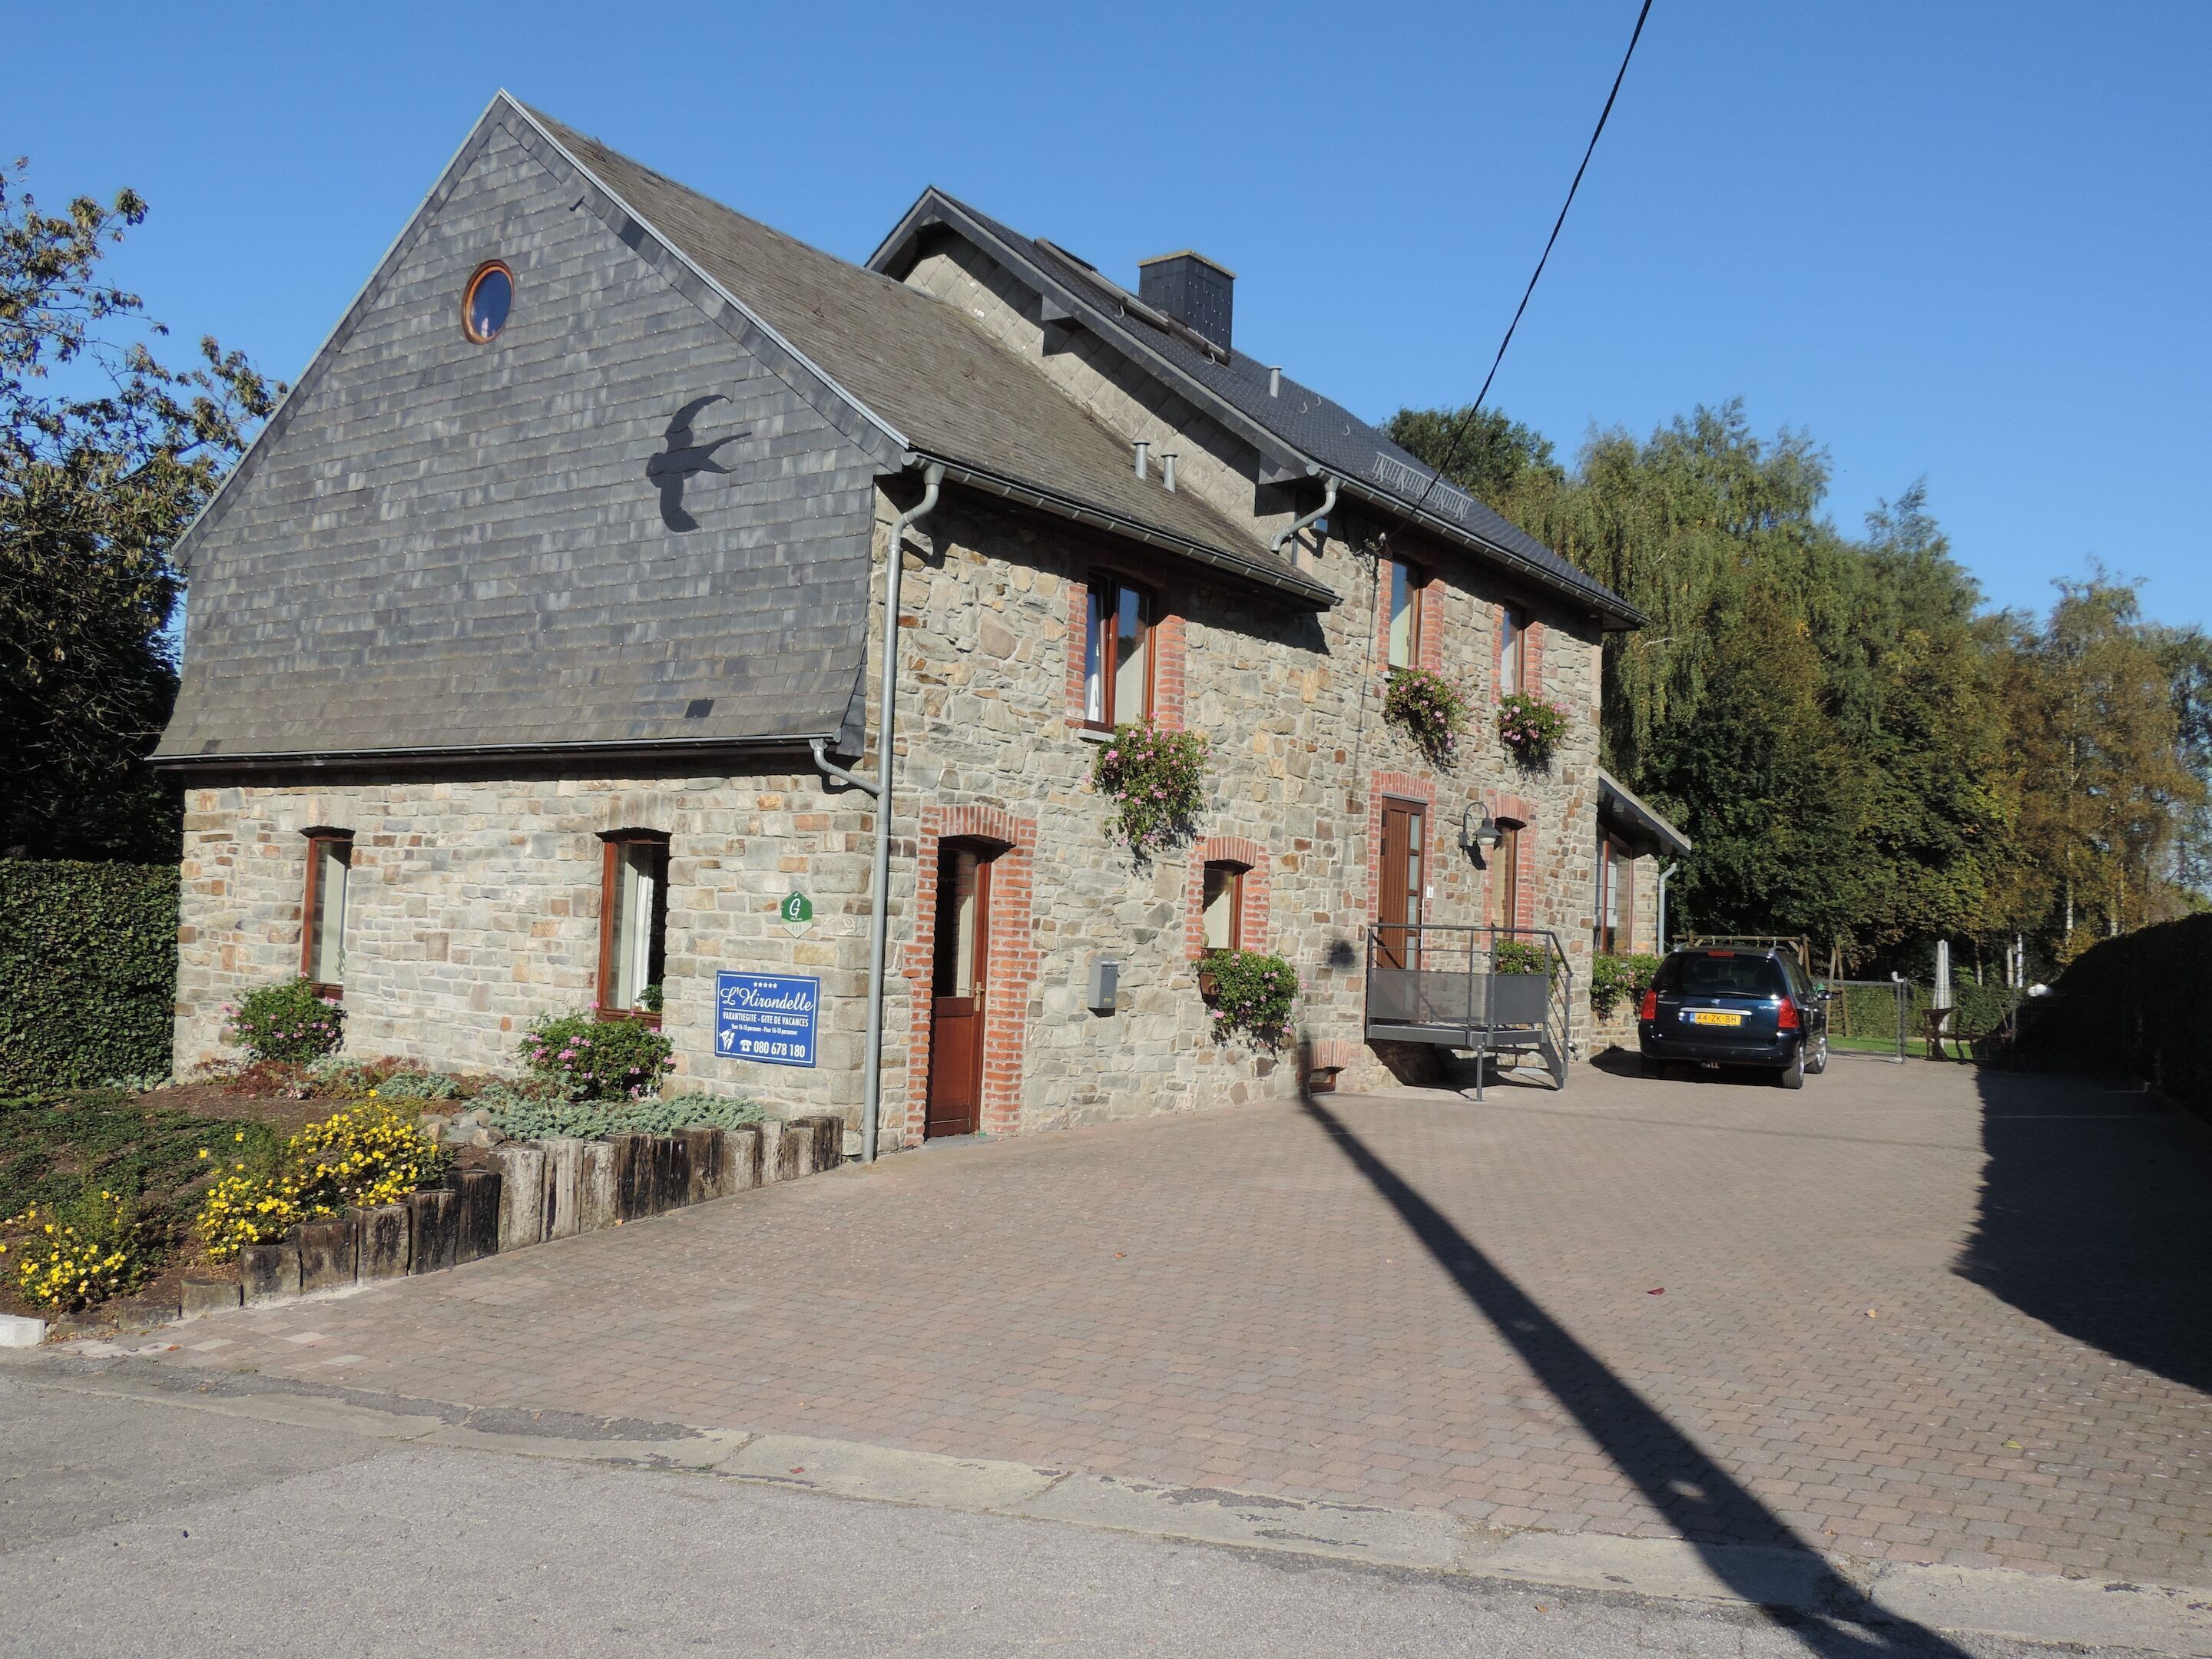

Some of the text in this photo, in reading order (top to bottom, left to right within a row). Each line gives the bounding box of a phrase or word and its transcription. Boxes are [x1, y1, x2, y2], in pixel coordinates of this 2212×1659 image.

[720, 986, 813, 1012] L'Hirondelle
[723, 1012, 757, 1022] VAKANTIEGITE
[761, 1015, 773, 1024] GITE
[773, 1016, 781, 1025] DE
[782, 1016, 809, 1028] VACANCES
[753, 1041, 805, 1058] 080 678 180
